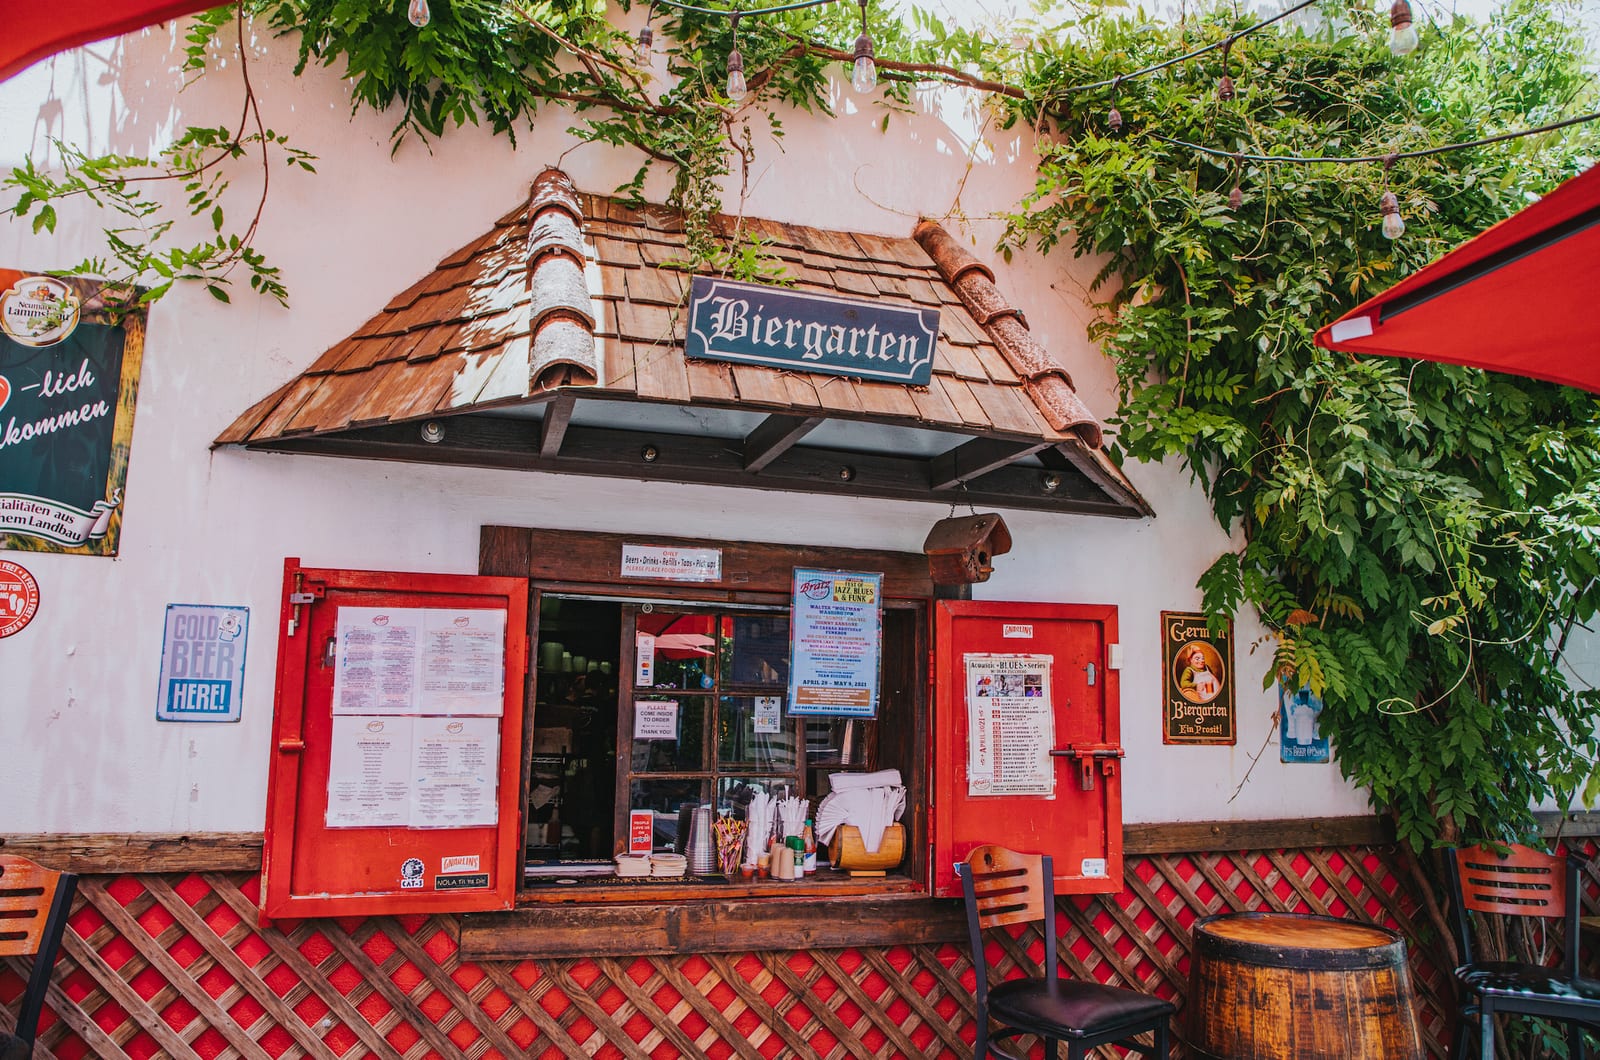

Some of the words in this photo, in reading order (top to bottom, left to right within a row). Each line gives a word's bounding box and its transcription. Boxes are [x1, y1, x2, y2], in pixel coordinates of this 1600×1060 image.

[708, 295, 921, 364] Biergarten
[0, 400, 110, 450] kommen
[0, 499, 51, 516] ialitäten
[54, 510, 75, 524] aus
[29, 515, 82, 541] Landbau
[625, 555, 639, 564] Beers
[643, 556, 659, 566] Drinks
[835, 586, 850, 594] JAZZ
[853, 587, 874, 595] BLUES
[173, 614, 219, 641] COLD
[1170, 619, 1226, 642] Germn
[169, 641, 235, 679] BEER
[999, 661, 1024, 670] BLUES
[172, 682, 226, 711] HERE!
[1170, 699, 1228, 724] Biergarten
[1179, 724, 1194, 734] Ein
[1194, 724, 1222, 735] Prosit!
[437, 878, 457, 886] NOLA
